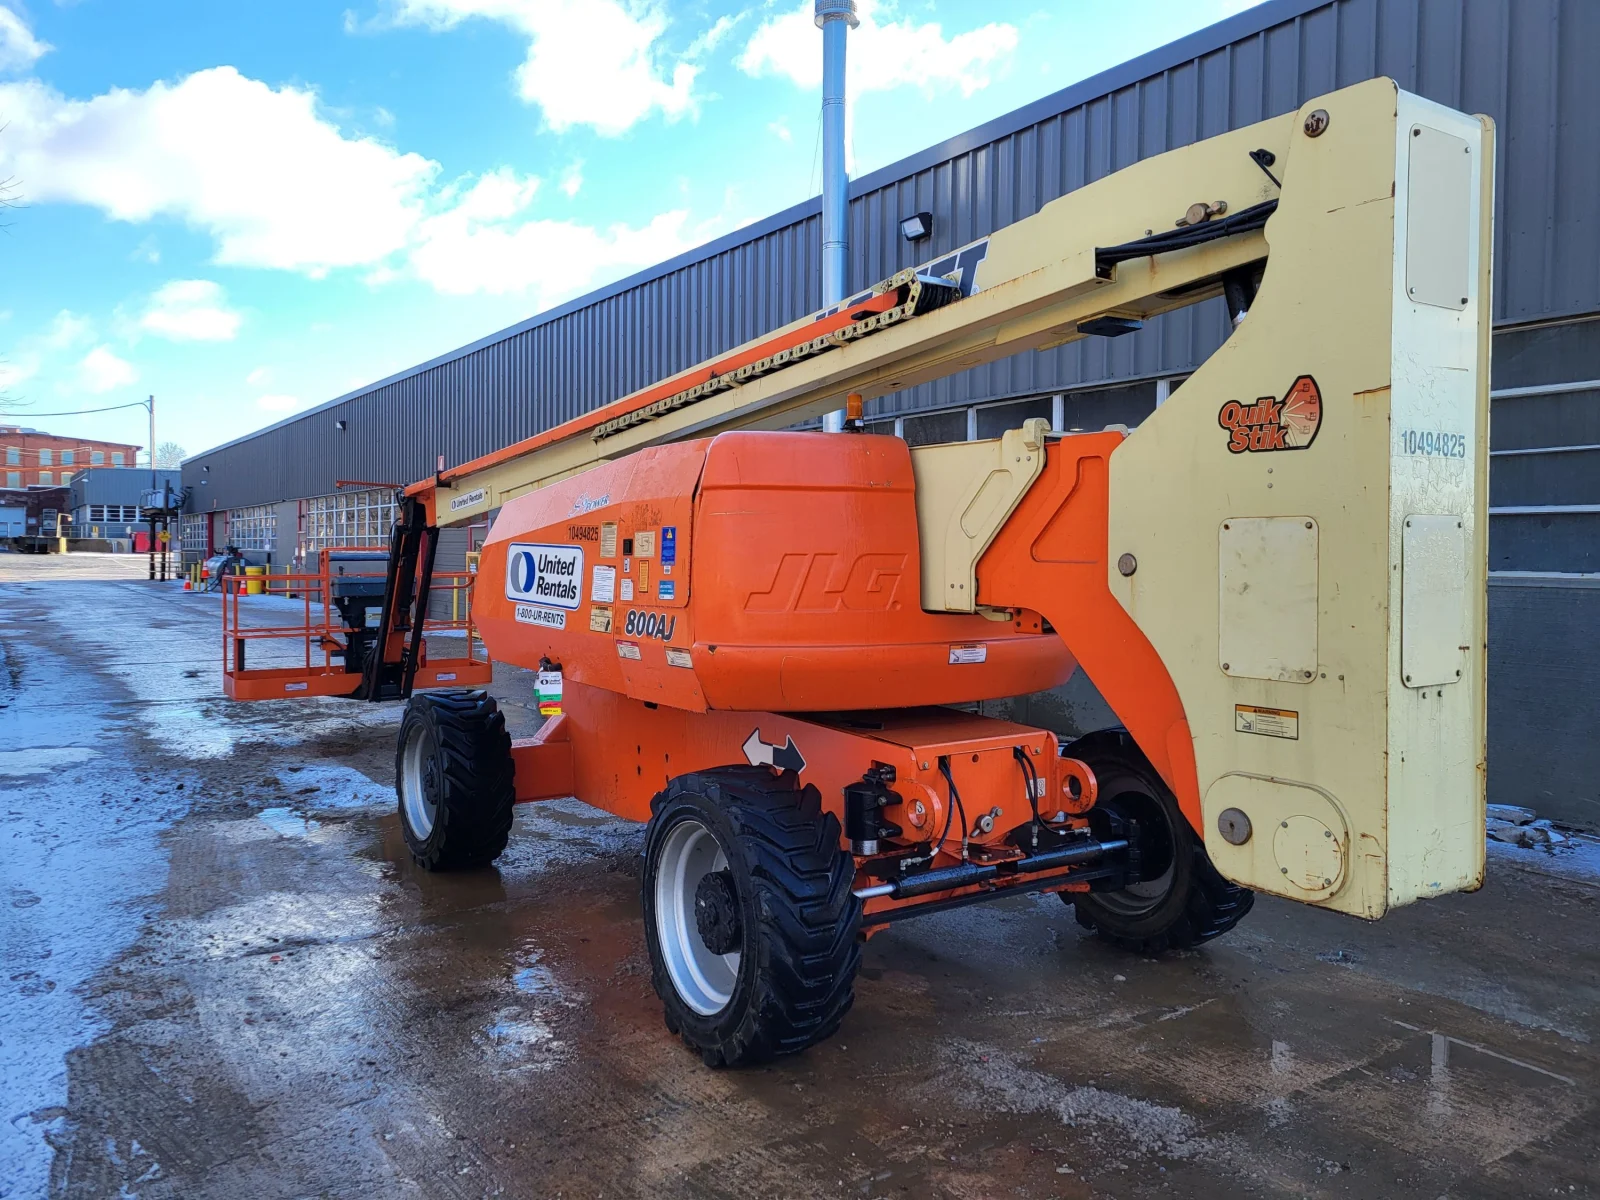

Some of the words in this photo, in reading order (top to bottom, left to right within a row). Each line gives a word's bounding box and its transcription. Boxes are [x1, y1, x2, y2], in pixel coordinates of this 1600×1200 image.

[1220, 398, 1283, 429] Quik
[1229, 425, 1290, 452] Stik
[1402, 430, 1466, 458] 10494825
[469, 491, 483, 504] Rentals
[568, 526, 599, 541] 10494825
[538, 553, 576, 576] United
[535, 575, 577, 600] Rentals
[743, 552, 908, 613] JLG
[516, 608, 565, 625] 1-800-UR-RENTS
[625, 609, 676, 641] 800AJ
